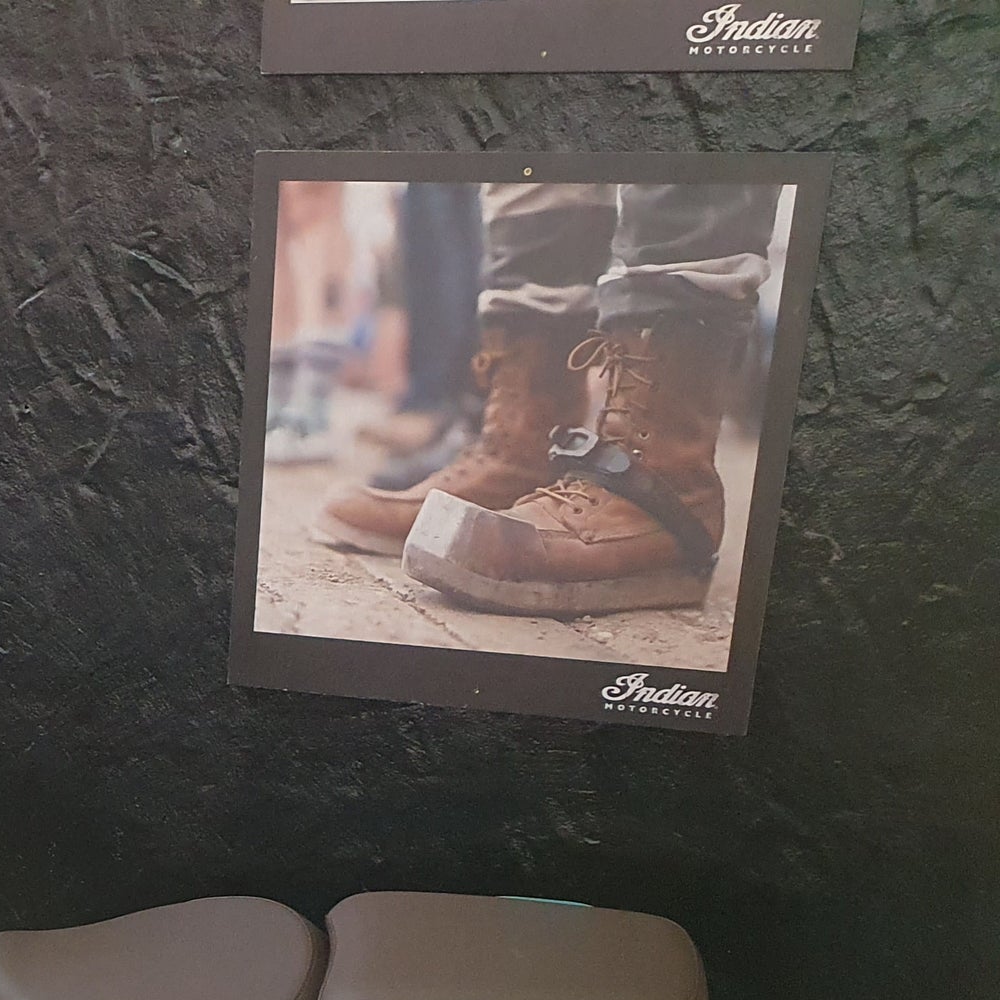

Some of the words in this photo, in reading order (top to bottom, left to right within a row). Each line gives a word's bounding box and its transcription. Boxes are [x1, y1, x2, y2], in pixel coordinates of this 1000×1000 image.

[686, 3, 821, 43] Indian
[688, 44, 813, 55] MOTORCYCLE
[601, 672, 720, 709] Indian
[604, 703, 713, 719] MOTORCYCLE
